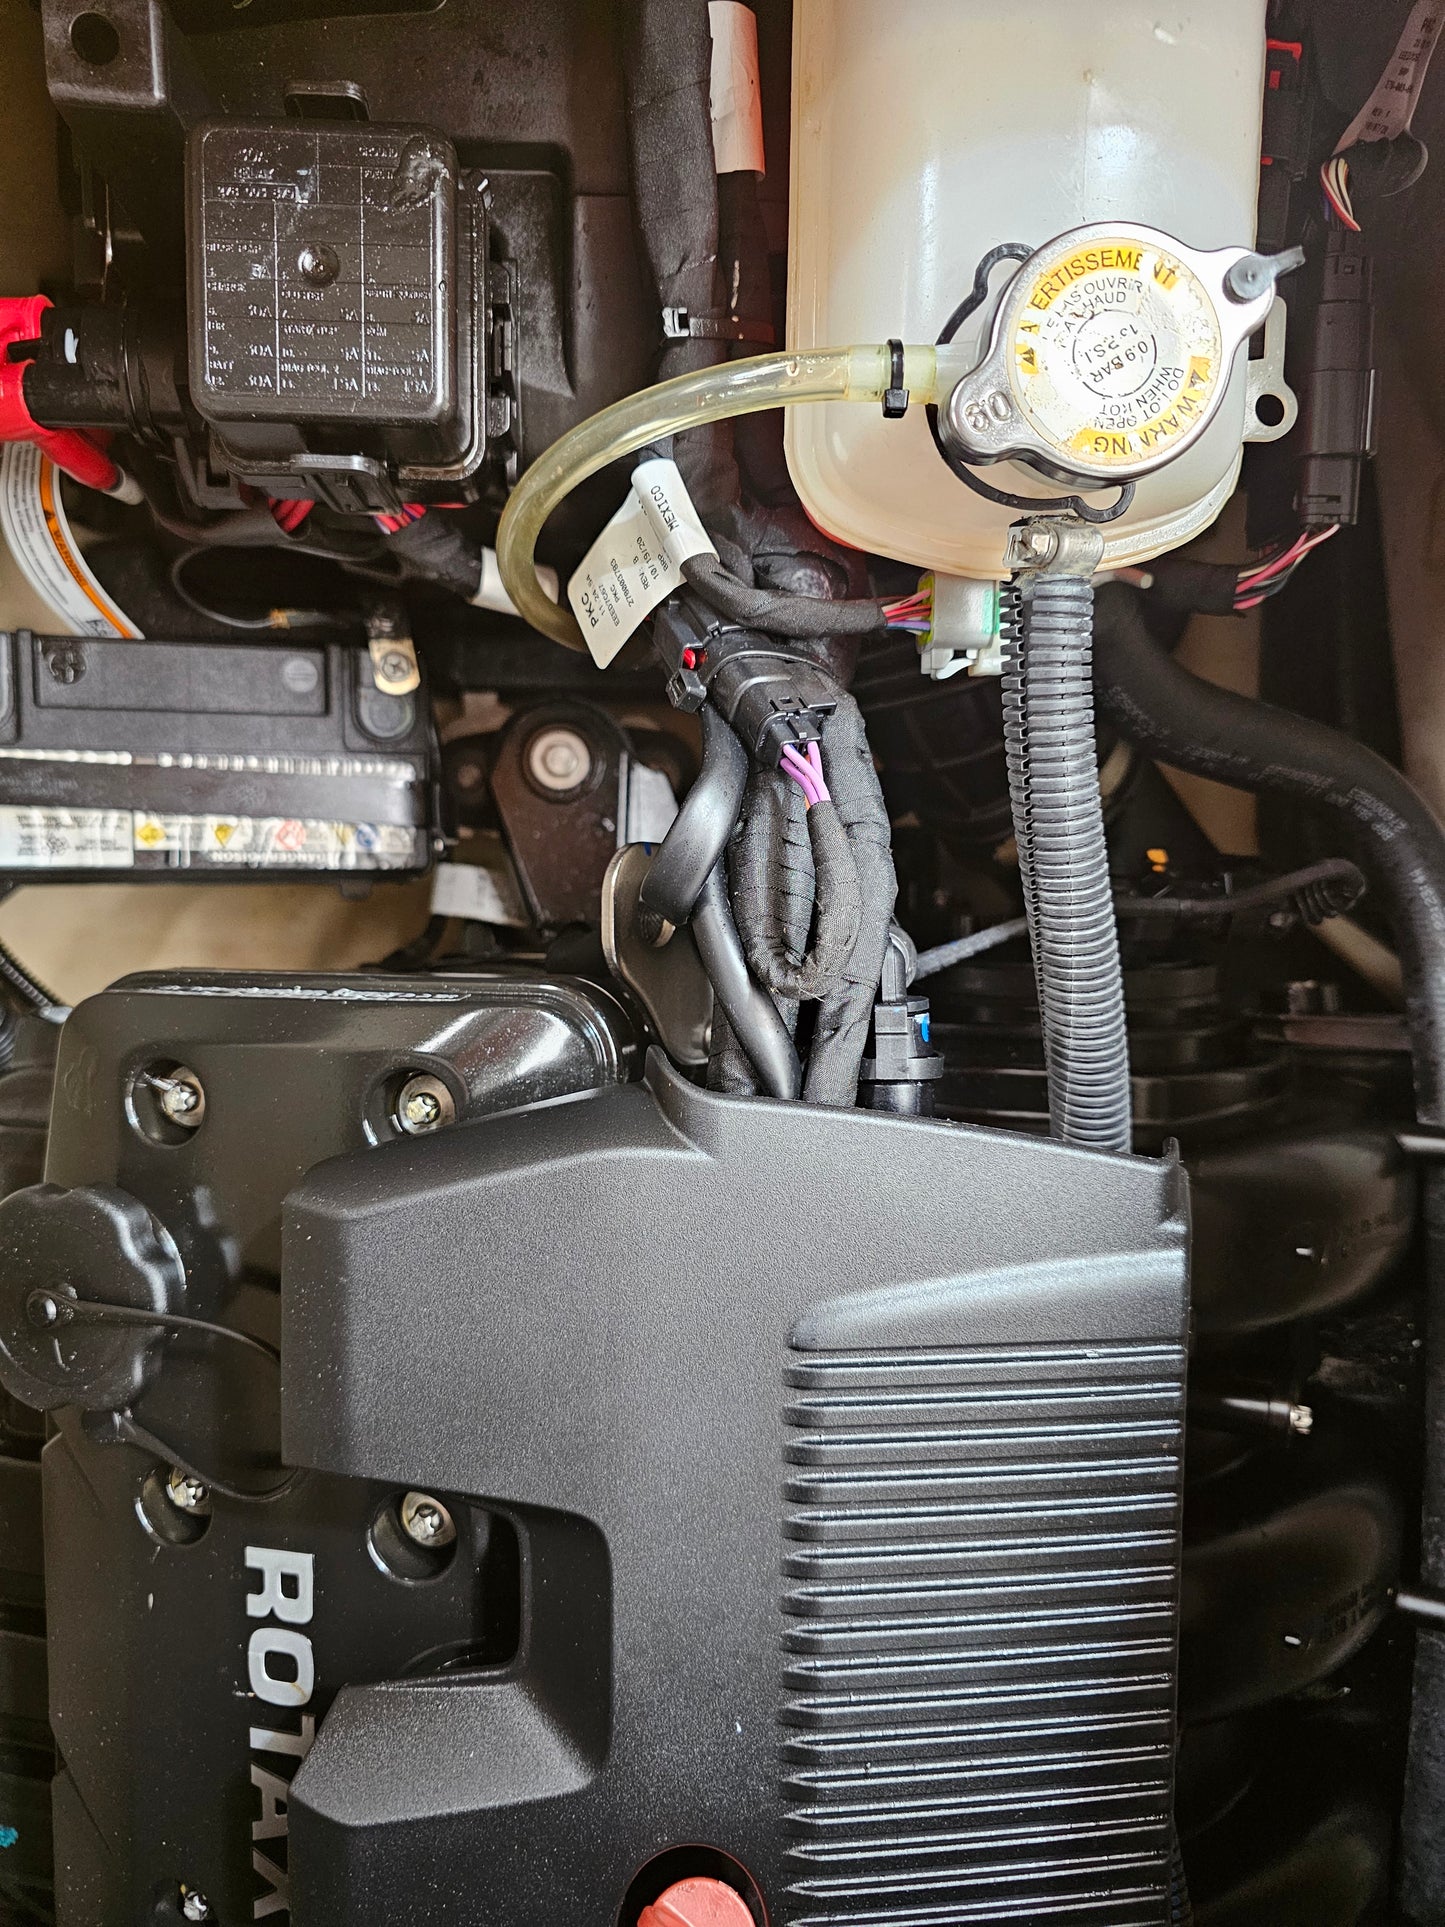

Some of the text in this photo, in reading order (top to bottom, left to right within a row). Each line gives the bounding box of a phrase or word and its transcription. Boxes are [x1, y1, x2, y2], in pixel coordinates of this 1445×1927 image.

[209, 360, 234, 370] BATT
[281, 363, 304, 373] DIAG
[1091, 351, 1126, 385] BAR
[1135, 366, 1173, 407] WHEN
[1167, 367, 1184, 391] DO
[1094, 415, 1137, 430] OPEN
[650, 485, 680, 532] MEXICO
[656, 553, 669, 571] BRP
[609, 583, 620, 603] PKC
[581, 591, 598, 628] PKC
